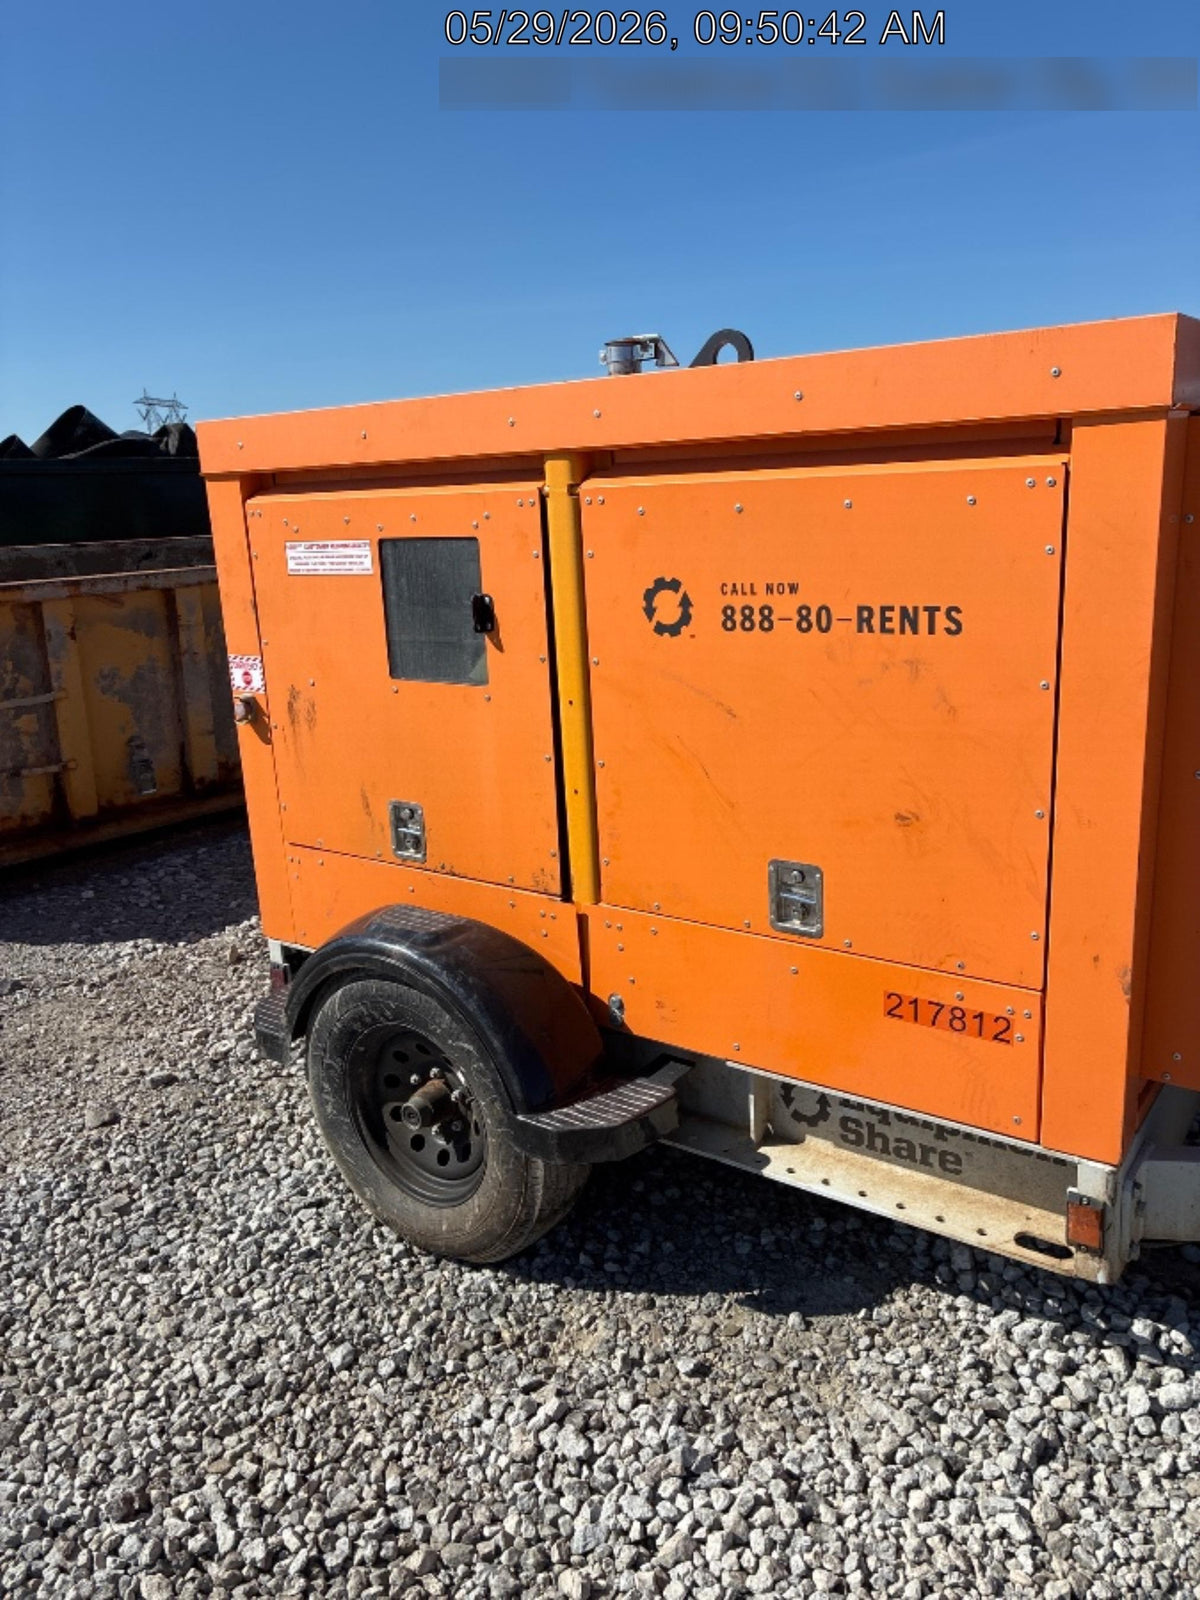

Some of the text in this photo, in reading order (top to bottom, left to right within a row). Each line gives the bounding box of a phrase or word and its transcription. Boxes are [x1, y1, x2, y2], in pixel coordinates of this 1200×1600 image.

[720, 582, 799, 596] CALL NOW
[721, 604, 963, 636] 888-80-RENTS
[886, 992, 1011, 1044] 217812
[838, 1115, 963, 1176] Share
